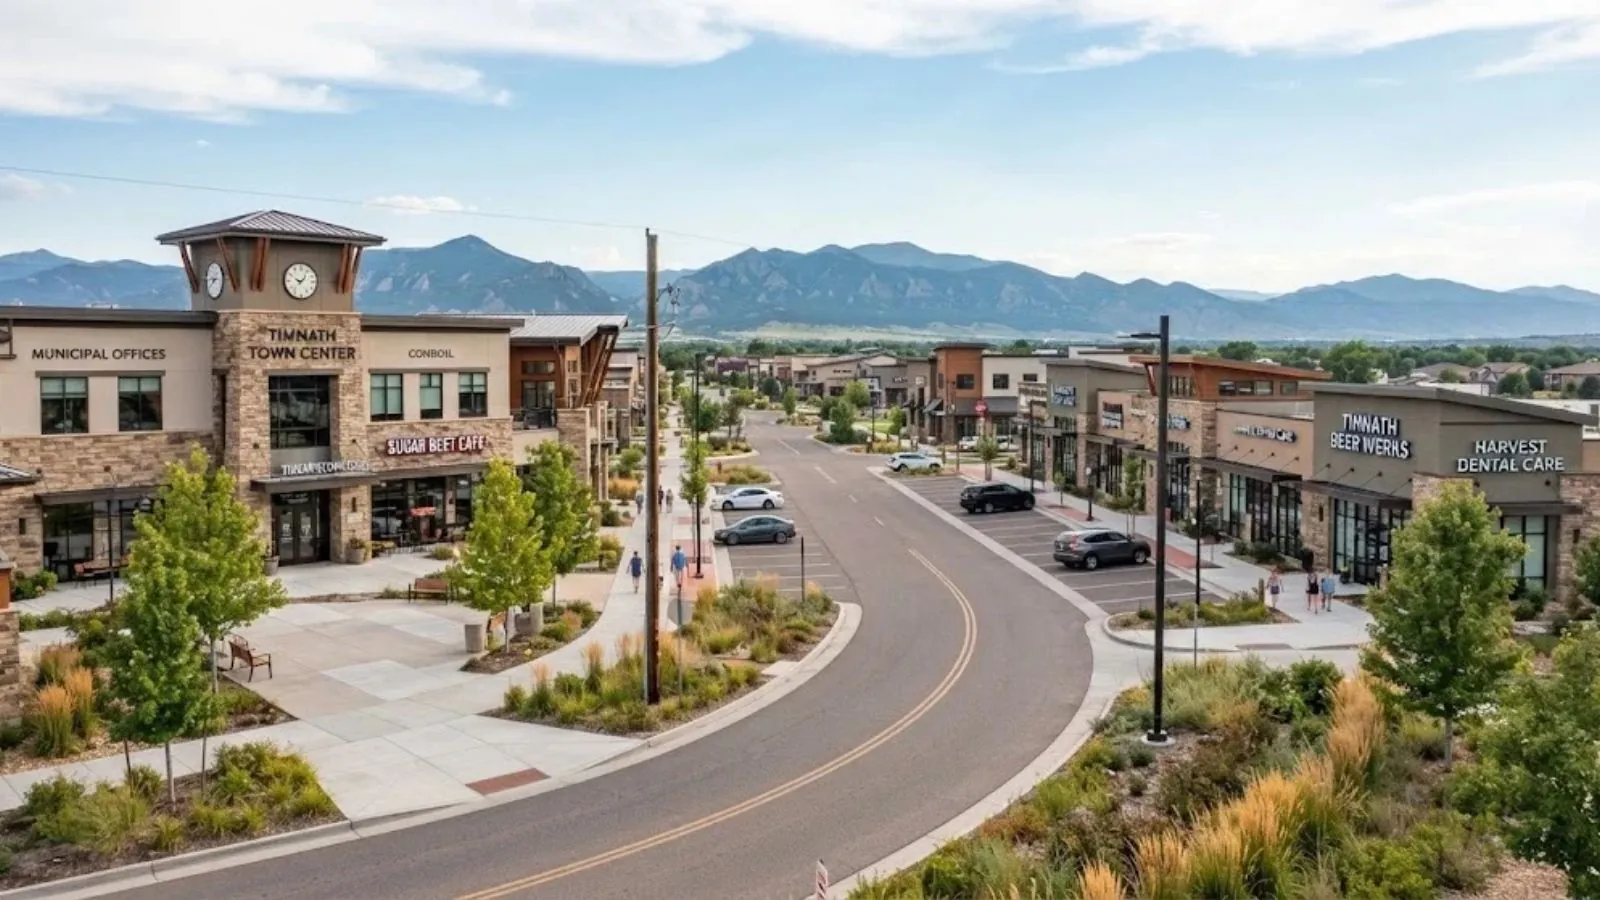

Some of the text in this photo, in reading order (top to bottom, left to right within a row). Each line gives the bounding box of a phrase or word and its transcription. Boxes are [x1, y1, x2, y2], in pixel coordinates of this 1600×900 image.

[268, 328, 337, 341] TIMNATH
[31, 348, 166, 360] MUNICIPAL OFFICES
[248, 346, 356, 360] TOWN CENTER
[1330, 432, 1361, 452] BEER
[1475, 439, 1548, 454] HARVEST
[1457, 457, 1566, 473] DENTAL CARE
